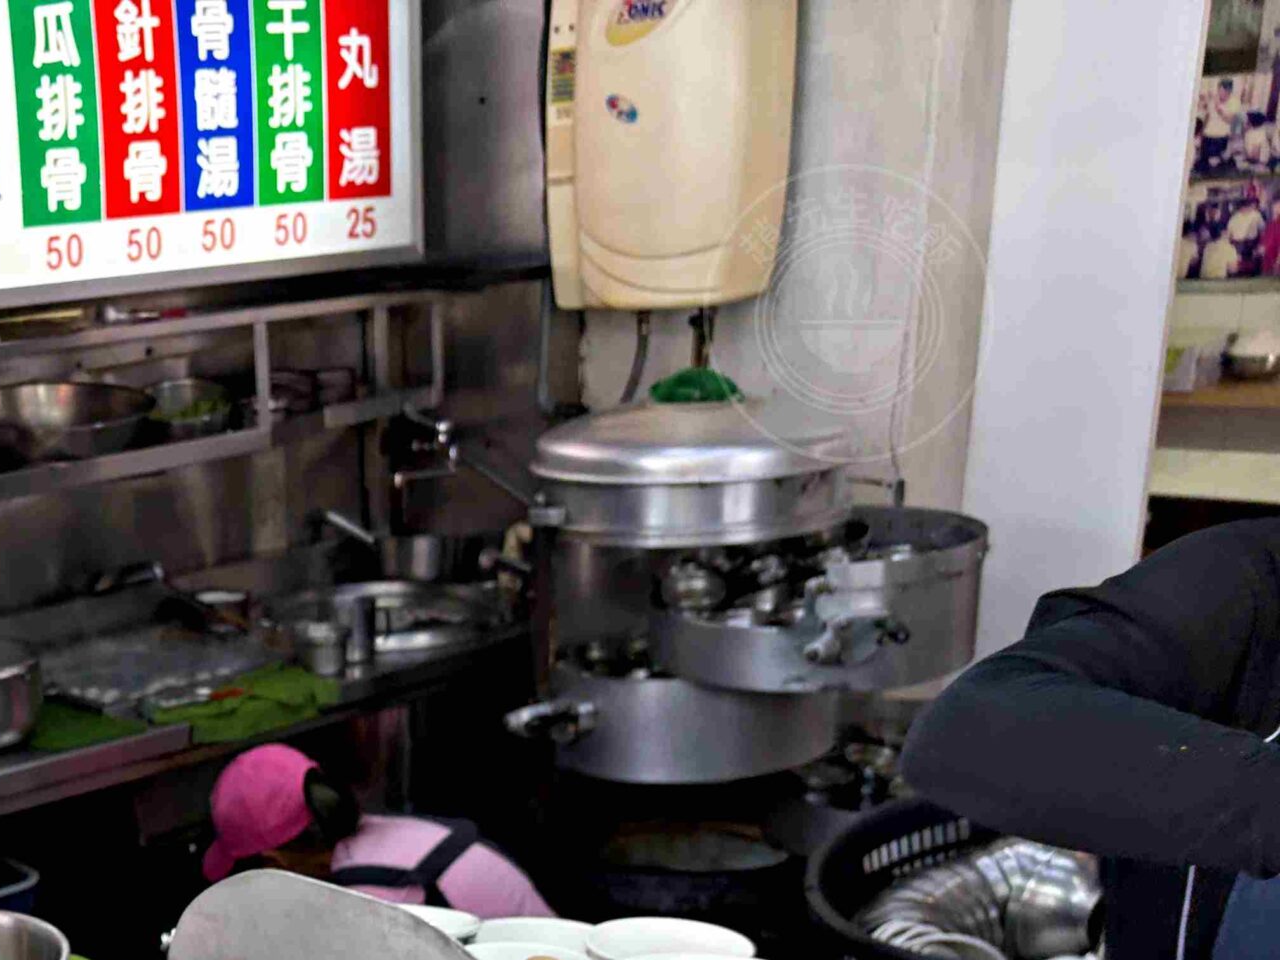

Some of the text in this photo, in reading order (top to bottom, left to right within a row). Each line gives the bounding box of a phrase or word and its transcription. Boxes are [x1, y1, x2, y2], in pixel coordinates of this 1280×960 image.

[31, 2, 87, 213] 瓜排骨
[337, 27, 380, 187] 丸湯
[202, 217, 236, 252] 50
[274, 211, 308, 246] 50
[346, 205, 377, 240] 25
[46, 233, 84, 270] 50
[126, 226, 162, 262] 50
